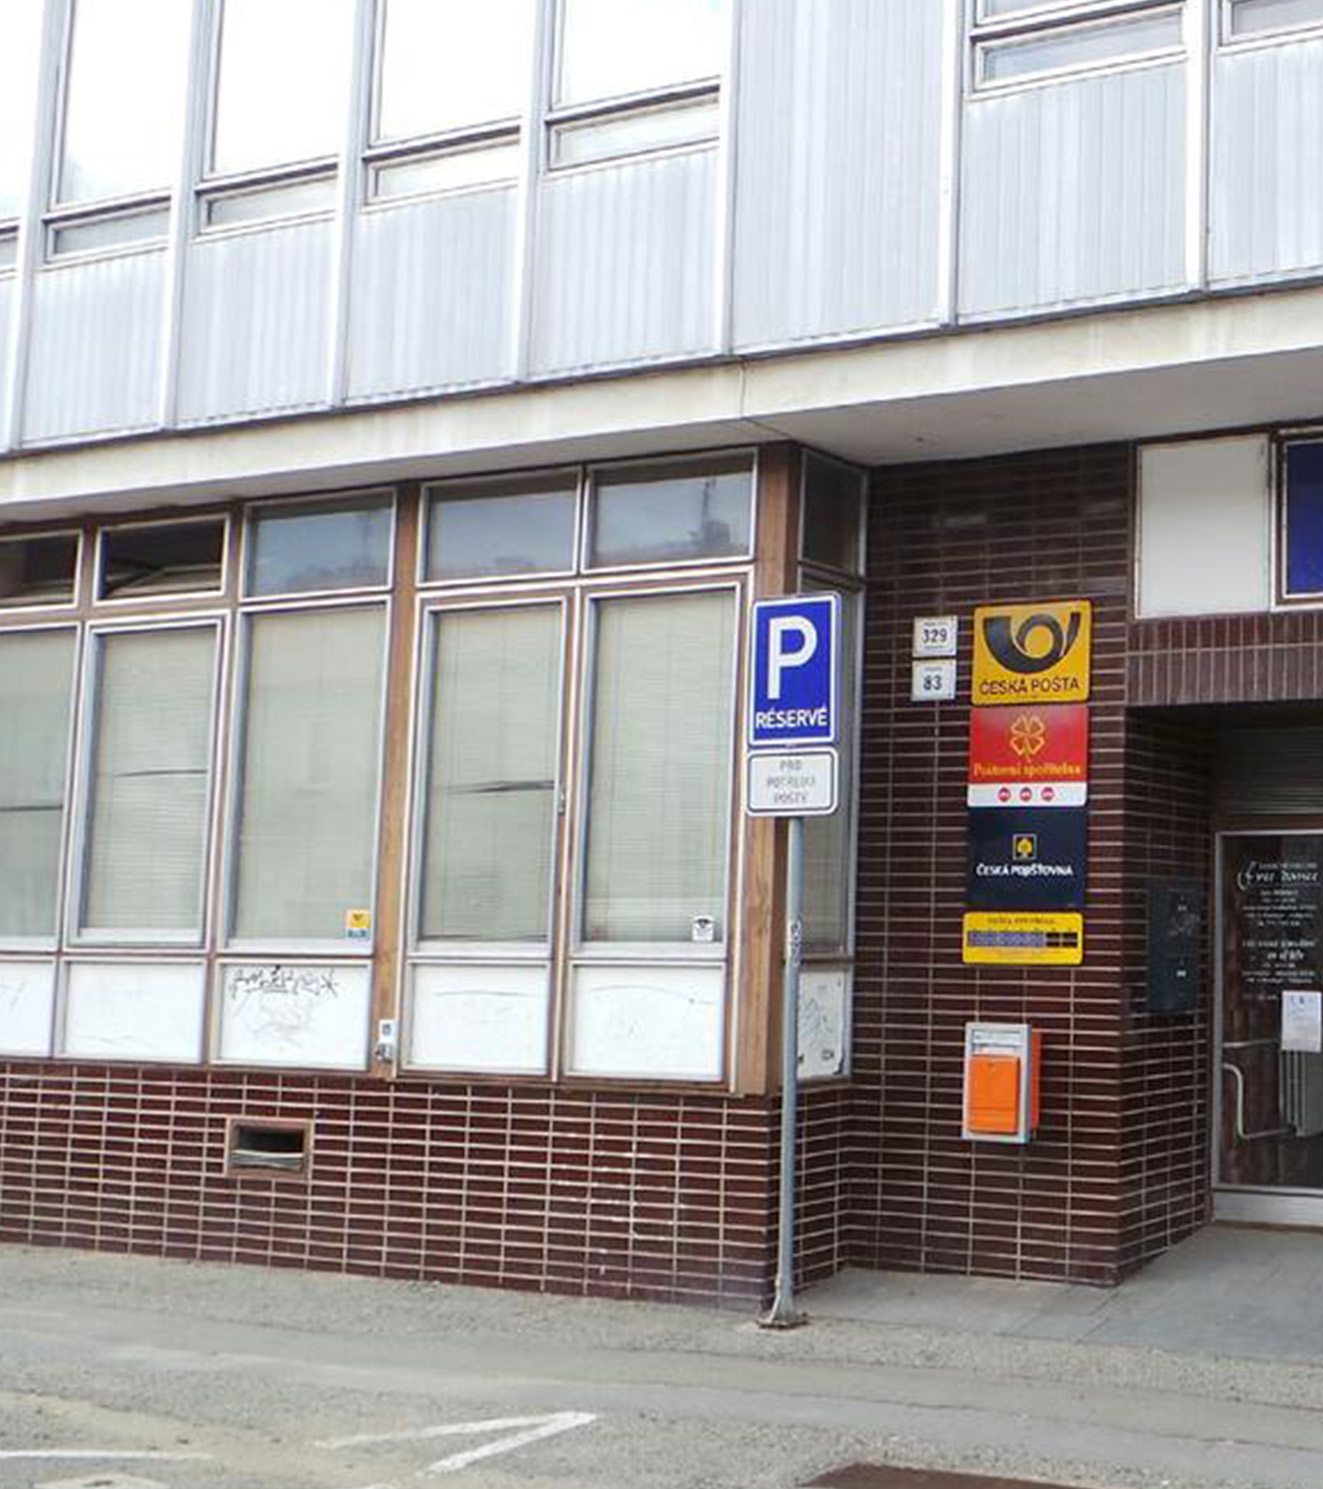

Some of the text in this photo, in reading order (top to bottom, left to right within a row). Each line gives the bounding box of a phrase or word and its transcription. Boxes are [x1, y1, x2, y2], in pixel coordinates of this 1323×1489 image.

[922, 628, 948, 644] 329
[767, 615, 818, 699] P
[923, 674, 943, 691] 83
[979, 676, 1080, 696] ČESKÁ POŠTA
[755, 703, 829, 729] RÉSERVÉ
[976, 862, 1009, 877] ČESKÁ
